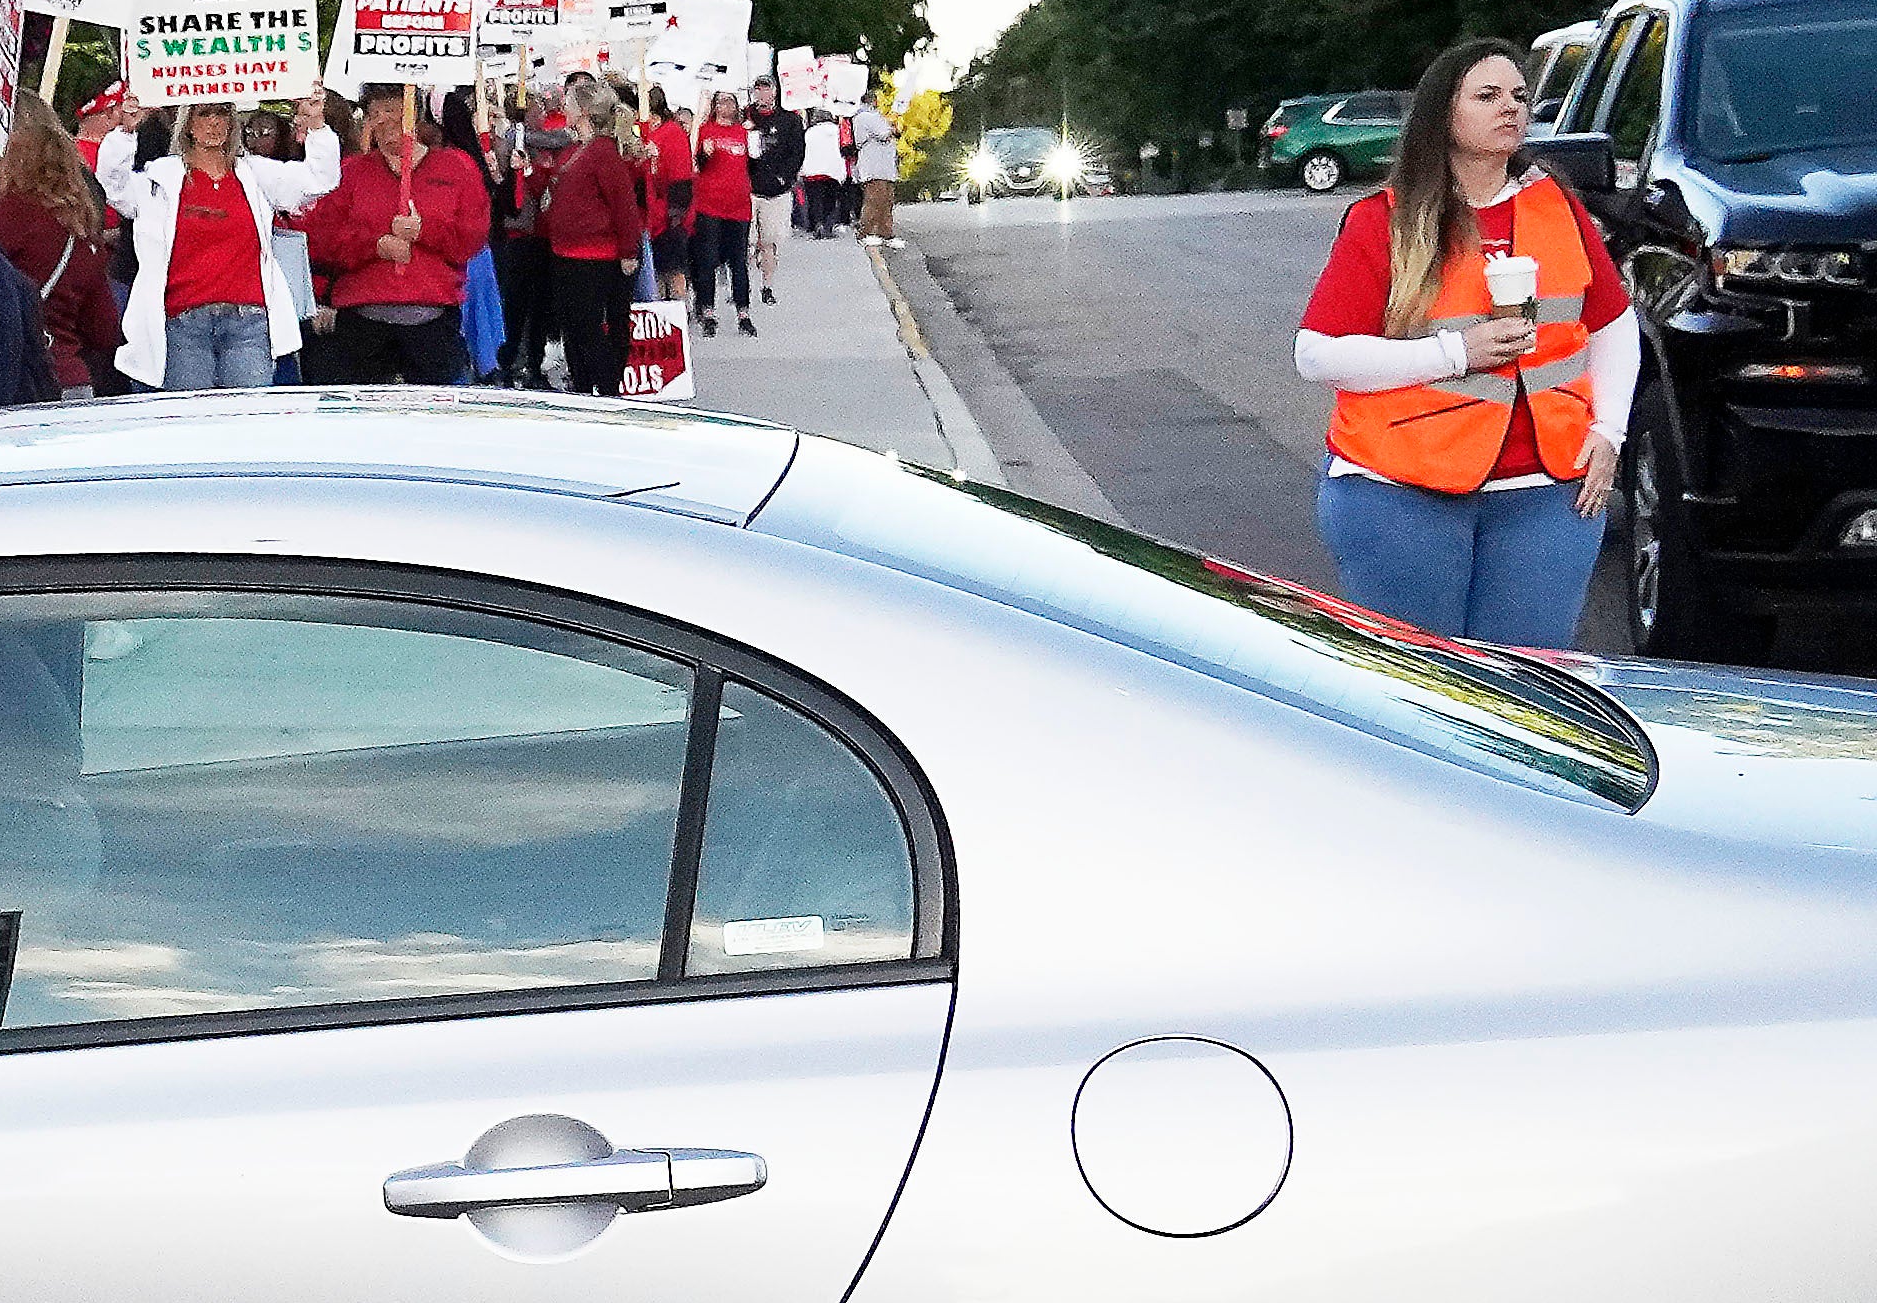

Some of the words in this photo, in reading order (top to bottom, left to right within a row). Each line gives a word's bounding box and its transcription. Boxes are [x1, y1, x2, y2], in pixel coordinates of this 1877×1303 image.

[139, 11, 242, 36] SHARE
[249, 8, 309, 31] THE
[161, 32, 286, 57] WEALTH
[359, 34, 465, 56] PROFITS
[151, 63, 228, 79] NURSES
[234, 60, 290, 76] HAVE
[164, 81, 246, 98] EARNED
